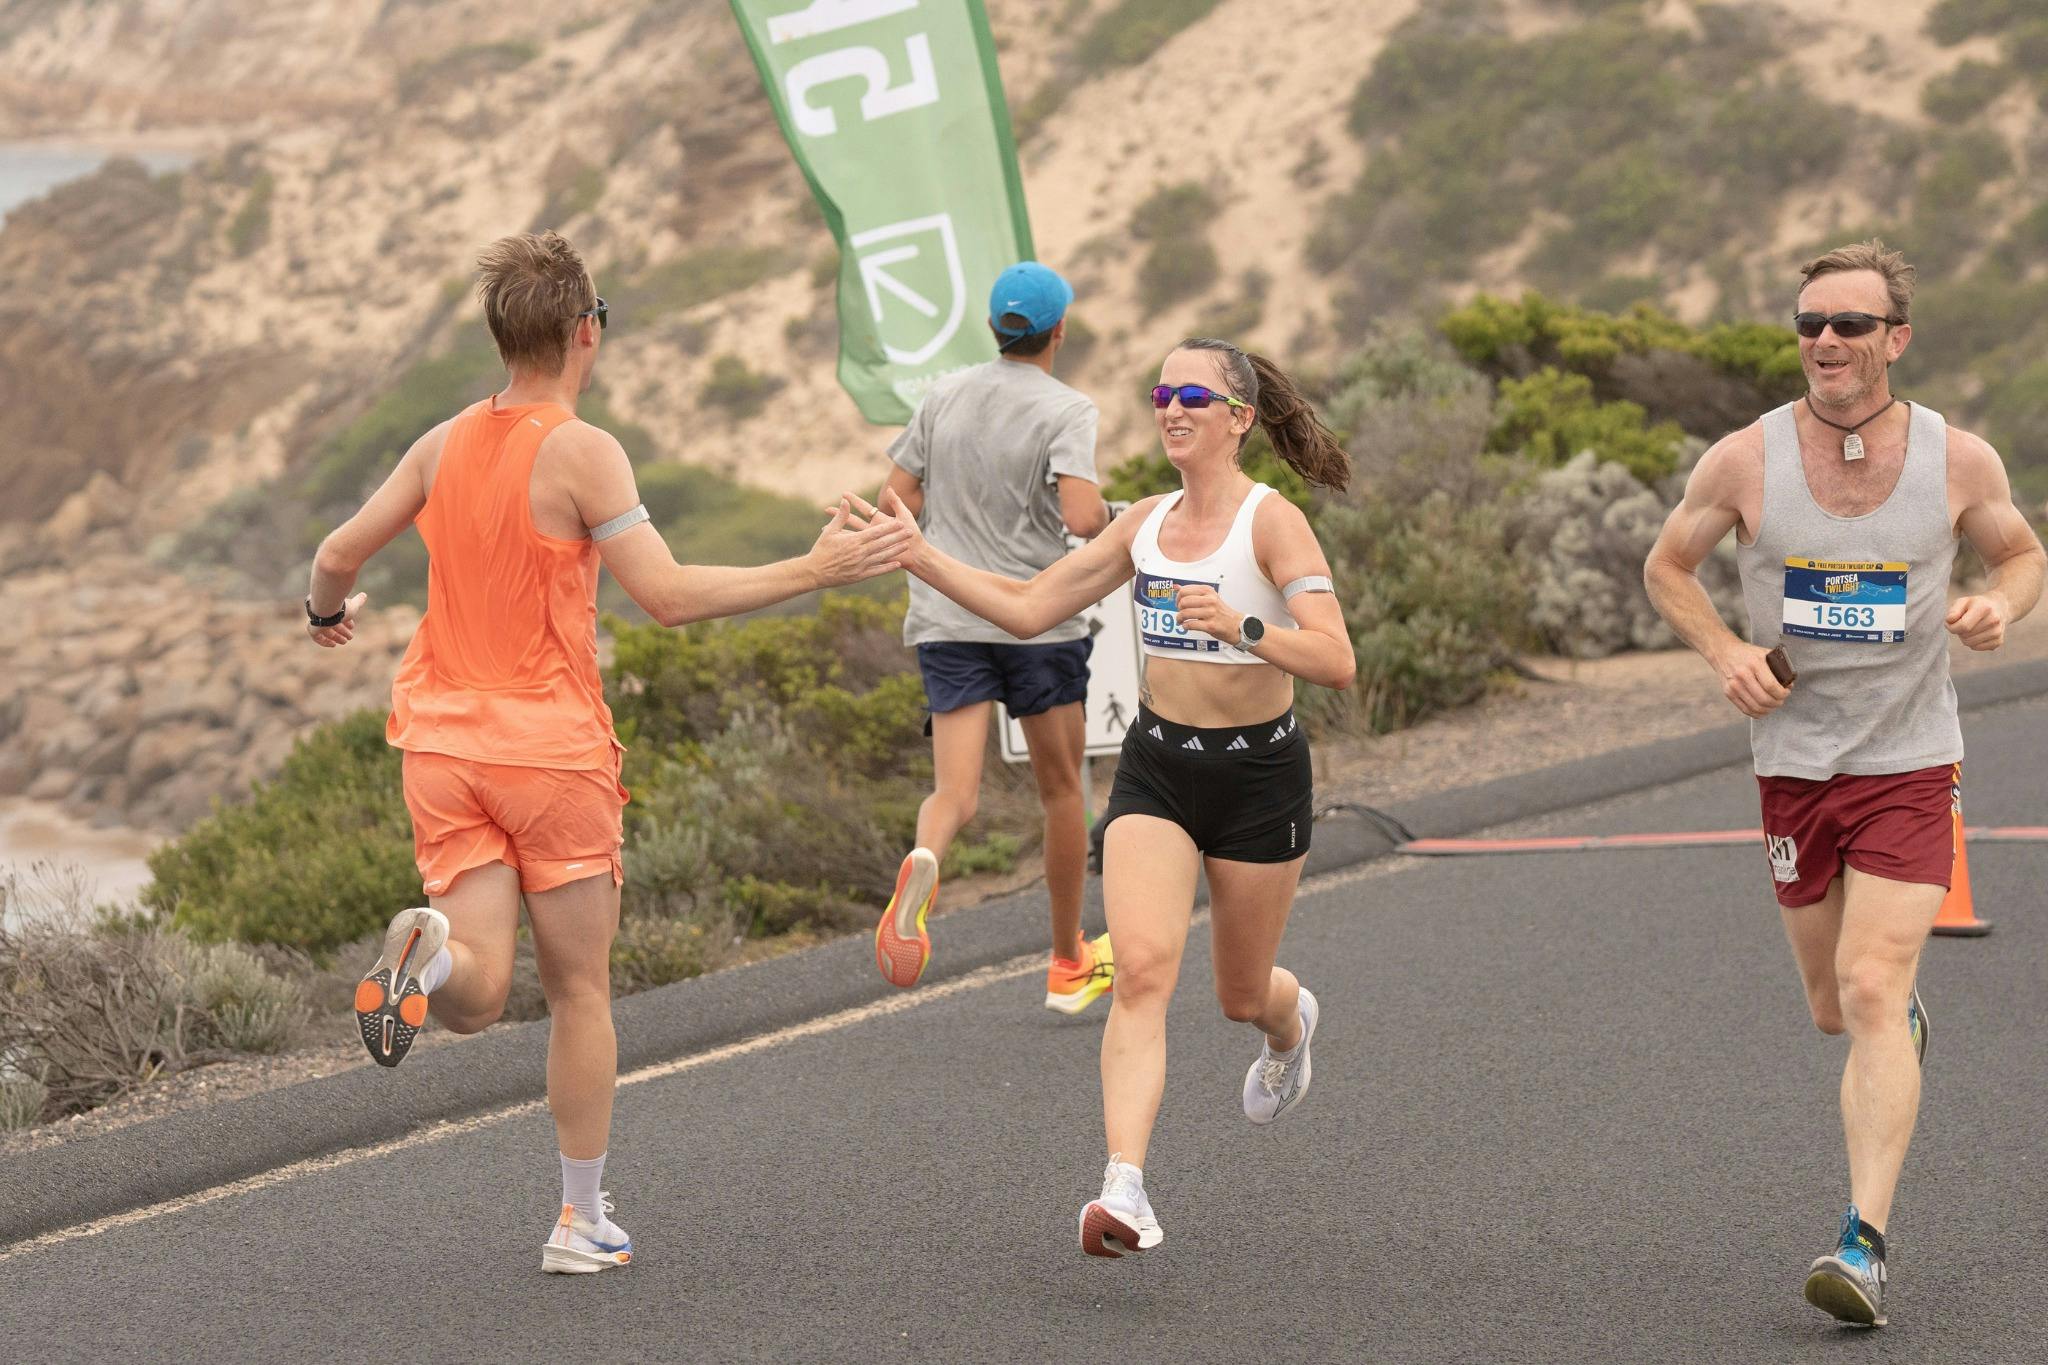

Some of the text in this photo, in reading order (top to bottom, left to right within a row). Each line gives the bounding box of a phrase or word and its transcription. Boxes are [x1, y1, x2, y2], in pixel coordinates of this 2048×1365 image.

[1148, 580, 1174, 590] PORTSEA
[1825, 573, 1858, 586] PORTSEA
[1148, 588, 1175, 598] TWILIGHT
[1824, 582, 1860, 594] TWILIGHT
[1813, 605, 1875, 628] 1563
